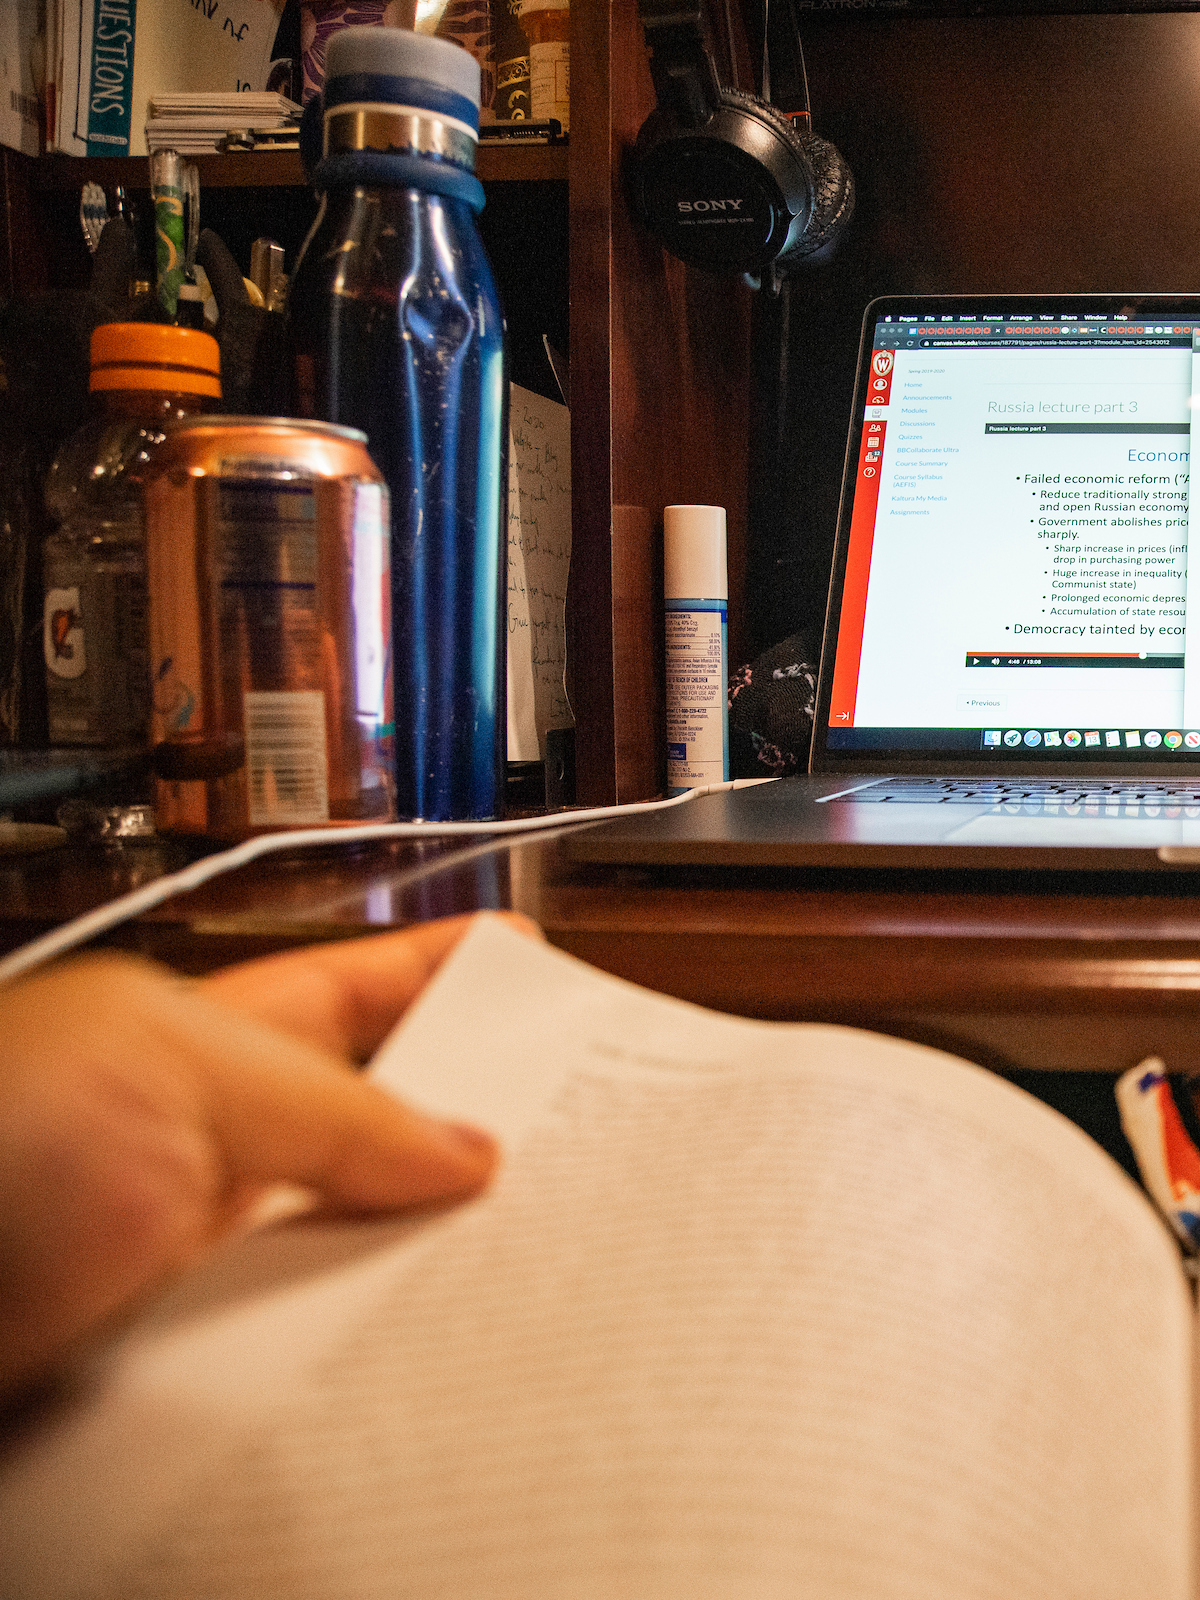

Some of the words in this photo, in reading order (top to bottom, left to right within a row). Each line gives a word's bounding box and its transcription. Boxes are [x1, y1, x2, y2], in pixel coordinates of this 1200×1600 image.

[677, 199, 743, 213] SONY
[876, 359, 890, 372] W
[988, 401, 1034, 412] Russia
[1038, 401, 1090, 412] lecture
[1094, 402, 1124, 414] part
[1128, 401, 1137, 412] 3
[1024, 473, 1060, 483] Failed
[1064, 474, 1124, 483] economic
[1128, 474, 1170, 483] reform
[1040, 489, 1080, 498] Reduce
[1083, 490, 1149, 500] traditionally
[1152, 491, 1187, 500] strong
[1039, 502, 1059, 510] and
[1062, 504, 1090, 512] open
[1094, 502, 1135, 511] Russian
[1139, 505, 1188, 513] economy
[1038, 517, 1106, 526] Government
[1110, 517, 1161, 526] abolishes
[1038, 529, 1079, 540] sharply.
[1054, 544, 1081, 553] Sharp
[1084, 544, 1123, 552] increase
[1126, 544, 1134, 552] in
[1138, 544, 1166, 553] prices
[1053, 555, 1075, 564] drop
[1090, 555, 1141, 565] purchasing
[1052, 569, 1076, 578] Huge
[1134, 569, 1182, 578] inequality
[1052, 580, 1106, 588] Communist
[1110, 580, 1136, 589] state)
[1051, 593, 1099, 603] Prolonged
[1102, 594, 1149, 602] economic
[1152, 594, 1185, 604] depres
[1050, 607, 1116, 615] Accumulation
[1119, 607, 1129, 615] of
[1158, 608, 1185, 616] resou
[1014, 624, 1085, 636] Democracy
[1089, 624, 1134, 634] tainted
[1140, 624, 1154, 636] by
[1088, 736, 1097, 744] 13
